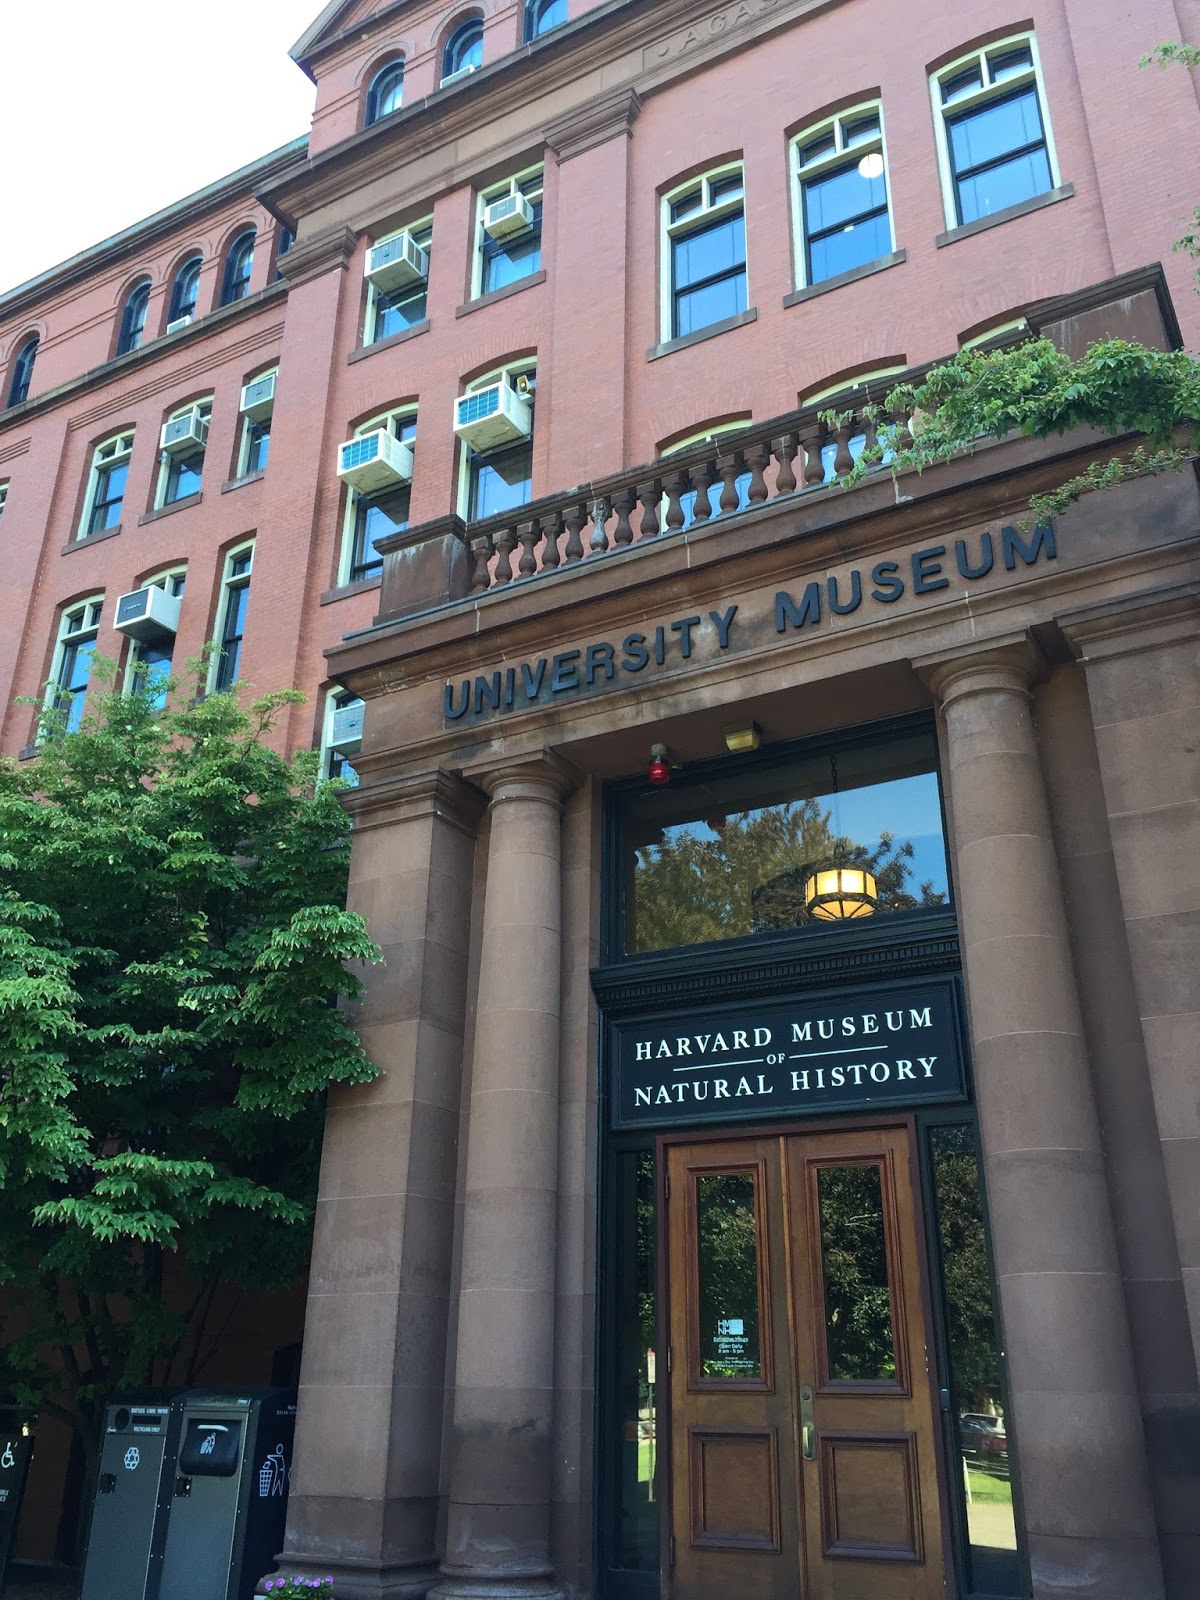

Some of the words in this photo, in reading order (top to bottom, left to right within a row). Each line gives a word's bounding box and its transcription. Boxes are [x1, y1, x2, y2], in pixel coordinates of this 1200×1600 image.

[443, 605, 738, 721] UNIVERSITY
[775, 516, 1057, 633] MUSEUM
[635, 1028, 772, 1060] HARVARD
[791, 1007, 934, 1043] MUSEUM
[766, 1052, 786, 1066] OF
[634, 1074, 774, 1107] NATURAL
[791, 1056, 938, 1092] HISTORY
